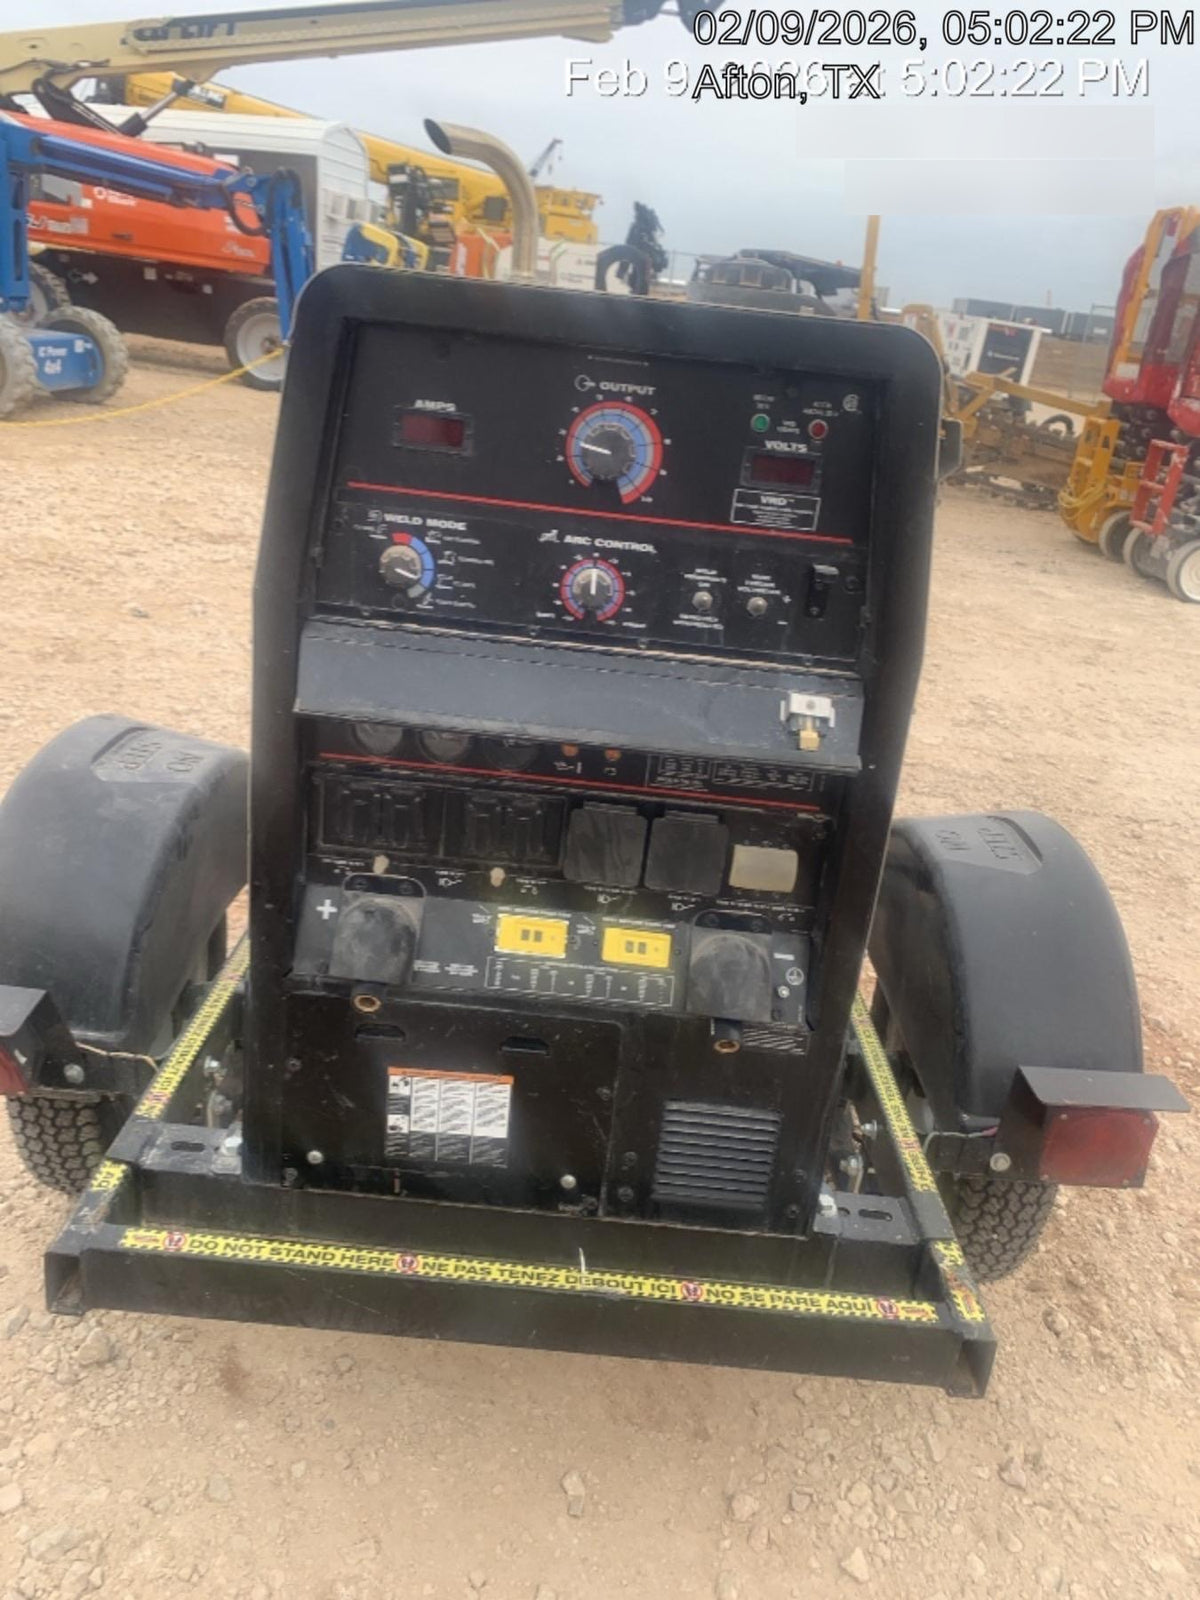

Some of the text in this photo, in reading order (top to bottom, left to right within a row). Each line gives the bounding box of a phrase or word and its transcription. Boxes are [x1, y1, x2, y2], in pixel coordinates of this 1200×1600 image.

[599, 381, 656, 395] OUTPUT
[414, 399, 456, 413] AMPS
[764, 439, 808, 453] VOLTS
[383, 512, 468, 531] WELD MODE
[563, 535, 658, 555] ARC CONTROL
[188, 1236, 394, 1267] DO NOT STAND HERE
[421, 1260, 448, 1272] NE
[453, 1263, 492, 1277] PAS
[500, 1268, 562, 1284] TENEZ
[650, 1283, 677, 1294] ICI
[705, 1287, 735, 1300] NO
[740, 1291, 766, 1303] SE
[769, 1294, 822, 1309] PARE
